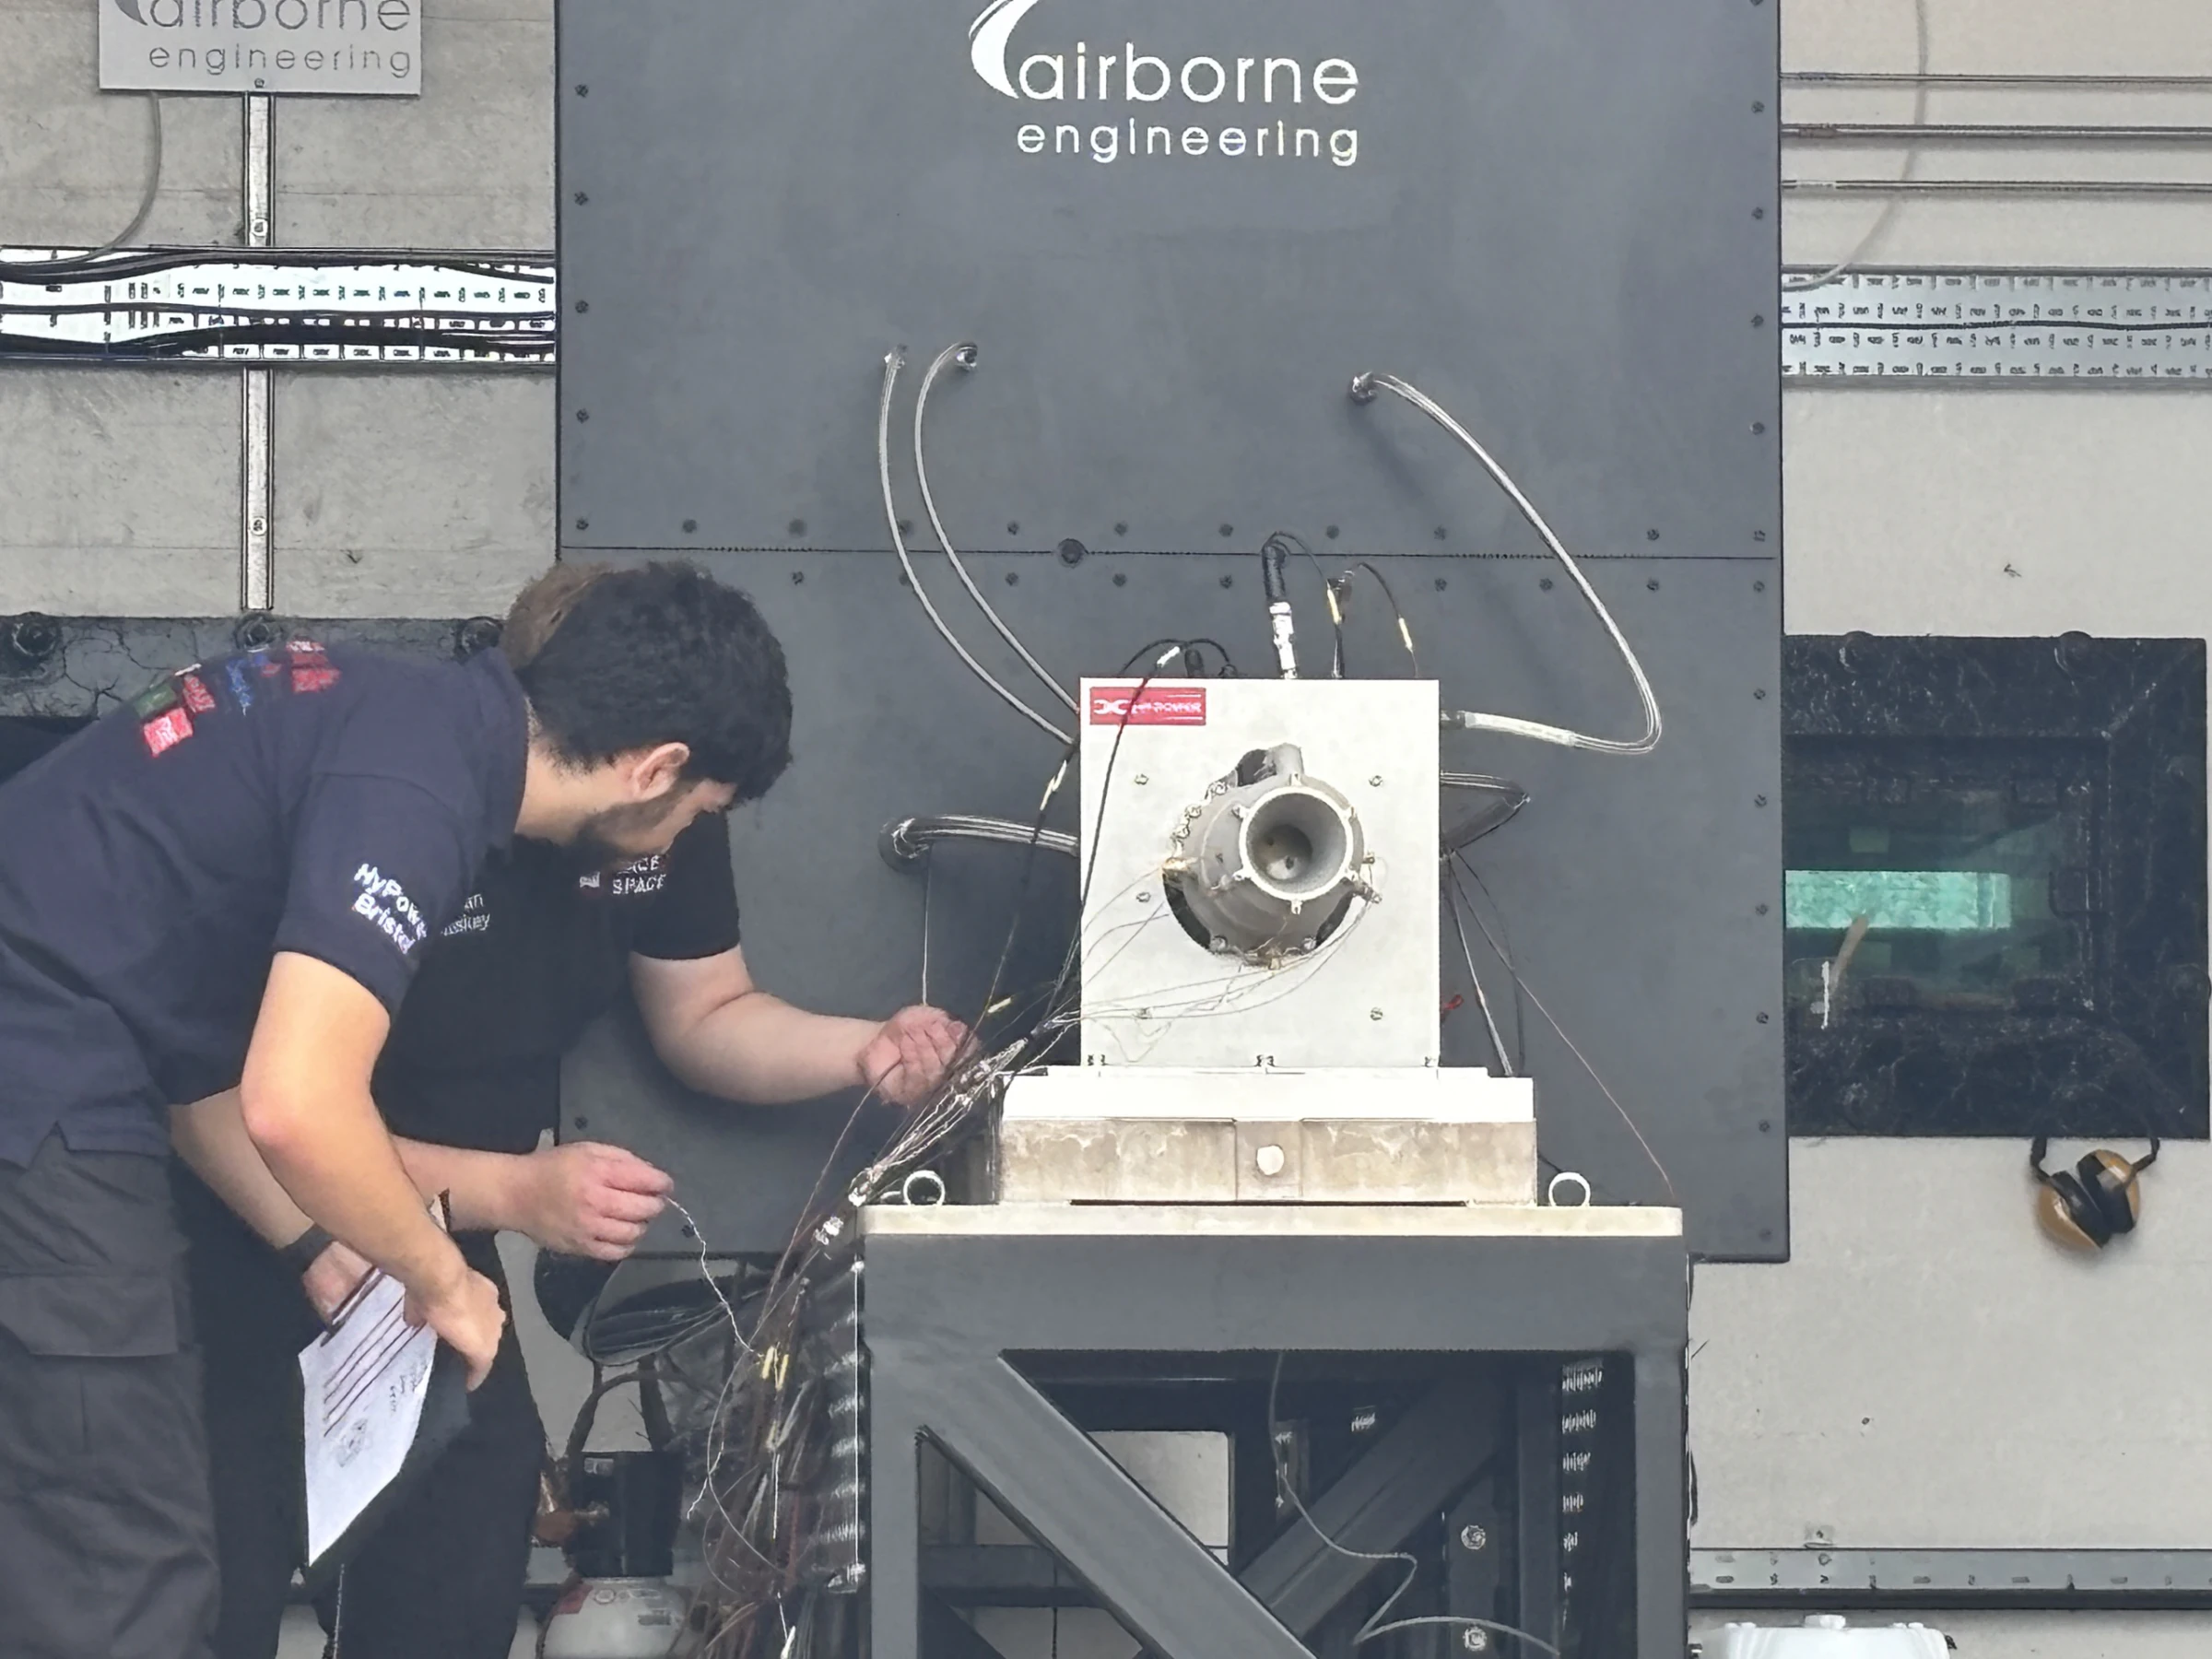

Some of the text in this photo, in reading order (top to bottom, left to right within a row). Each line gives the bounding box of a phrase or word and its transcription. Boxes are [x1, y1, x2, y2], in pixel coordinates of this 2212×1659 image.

[149, 44, 411, 78] engineering
[1018, 41, 1359, 104] airborne
[1018, 118, 1358, 166] engineering
[352, 893, 416, 954] Bristol
